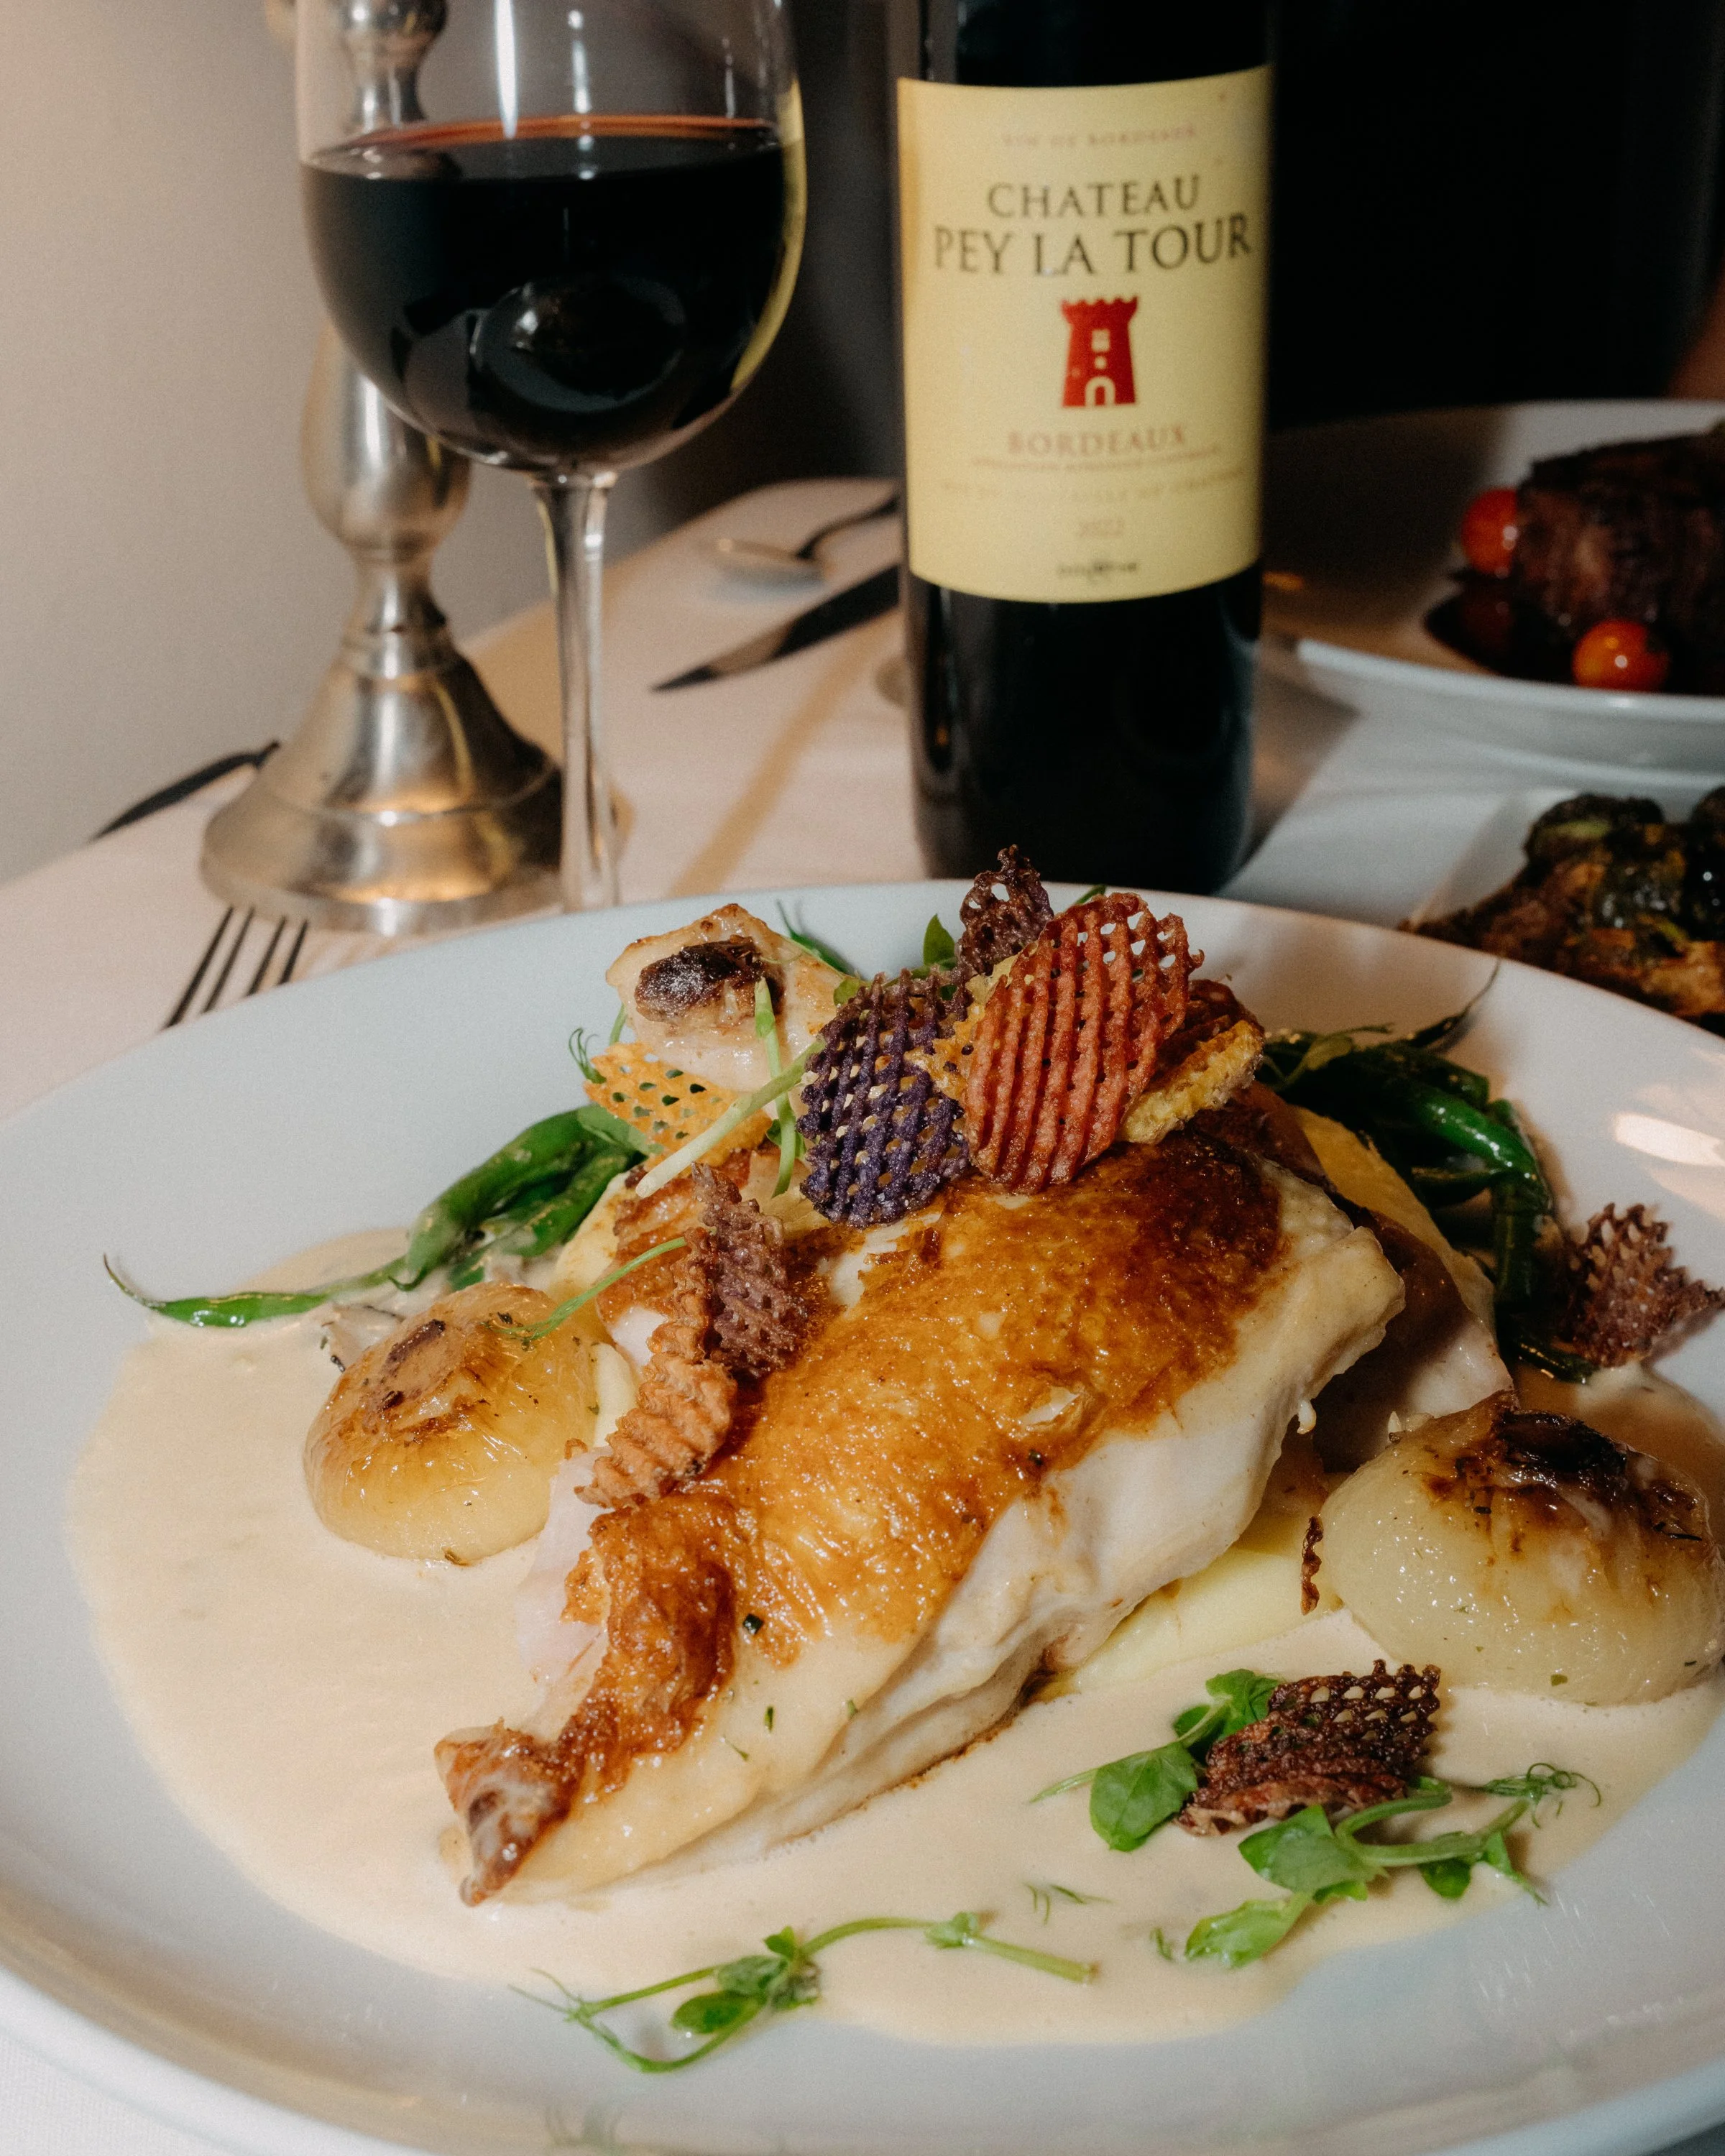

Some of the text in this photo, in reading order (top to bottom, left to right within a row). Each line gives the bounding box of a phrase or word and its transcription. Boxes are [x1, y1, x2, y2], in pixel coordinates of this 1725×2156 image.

[987, 174, 1200, 217] CHATEAU
[934, 213, 1251, 275] PEY LA TOUR
[1008, 425, 1186, 456] BORDEAUX
